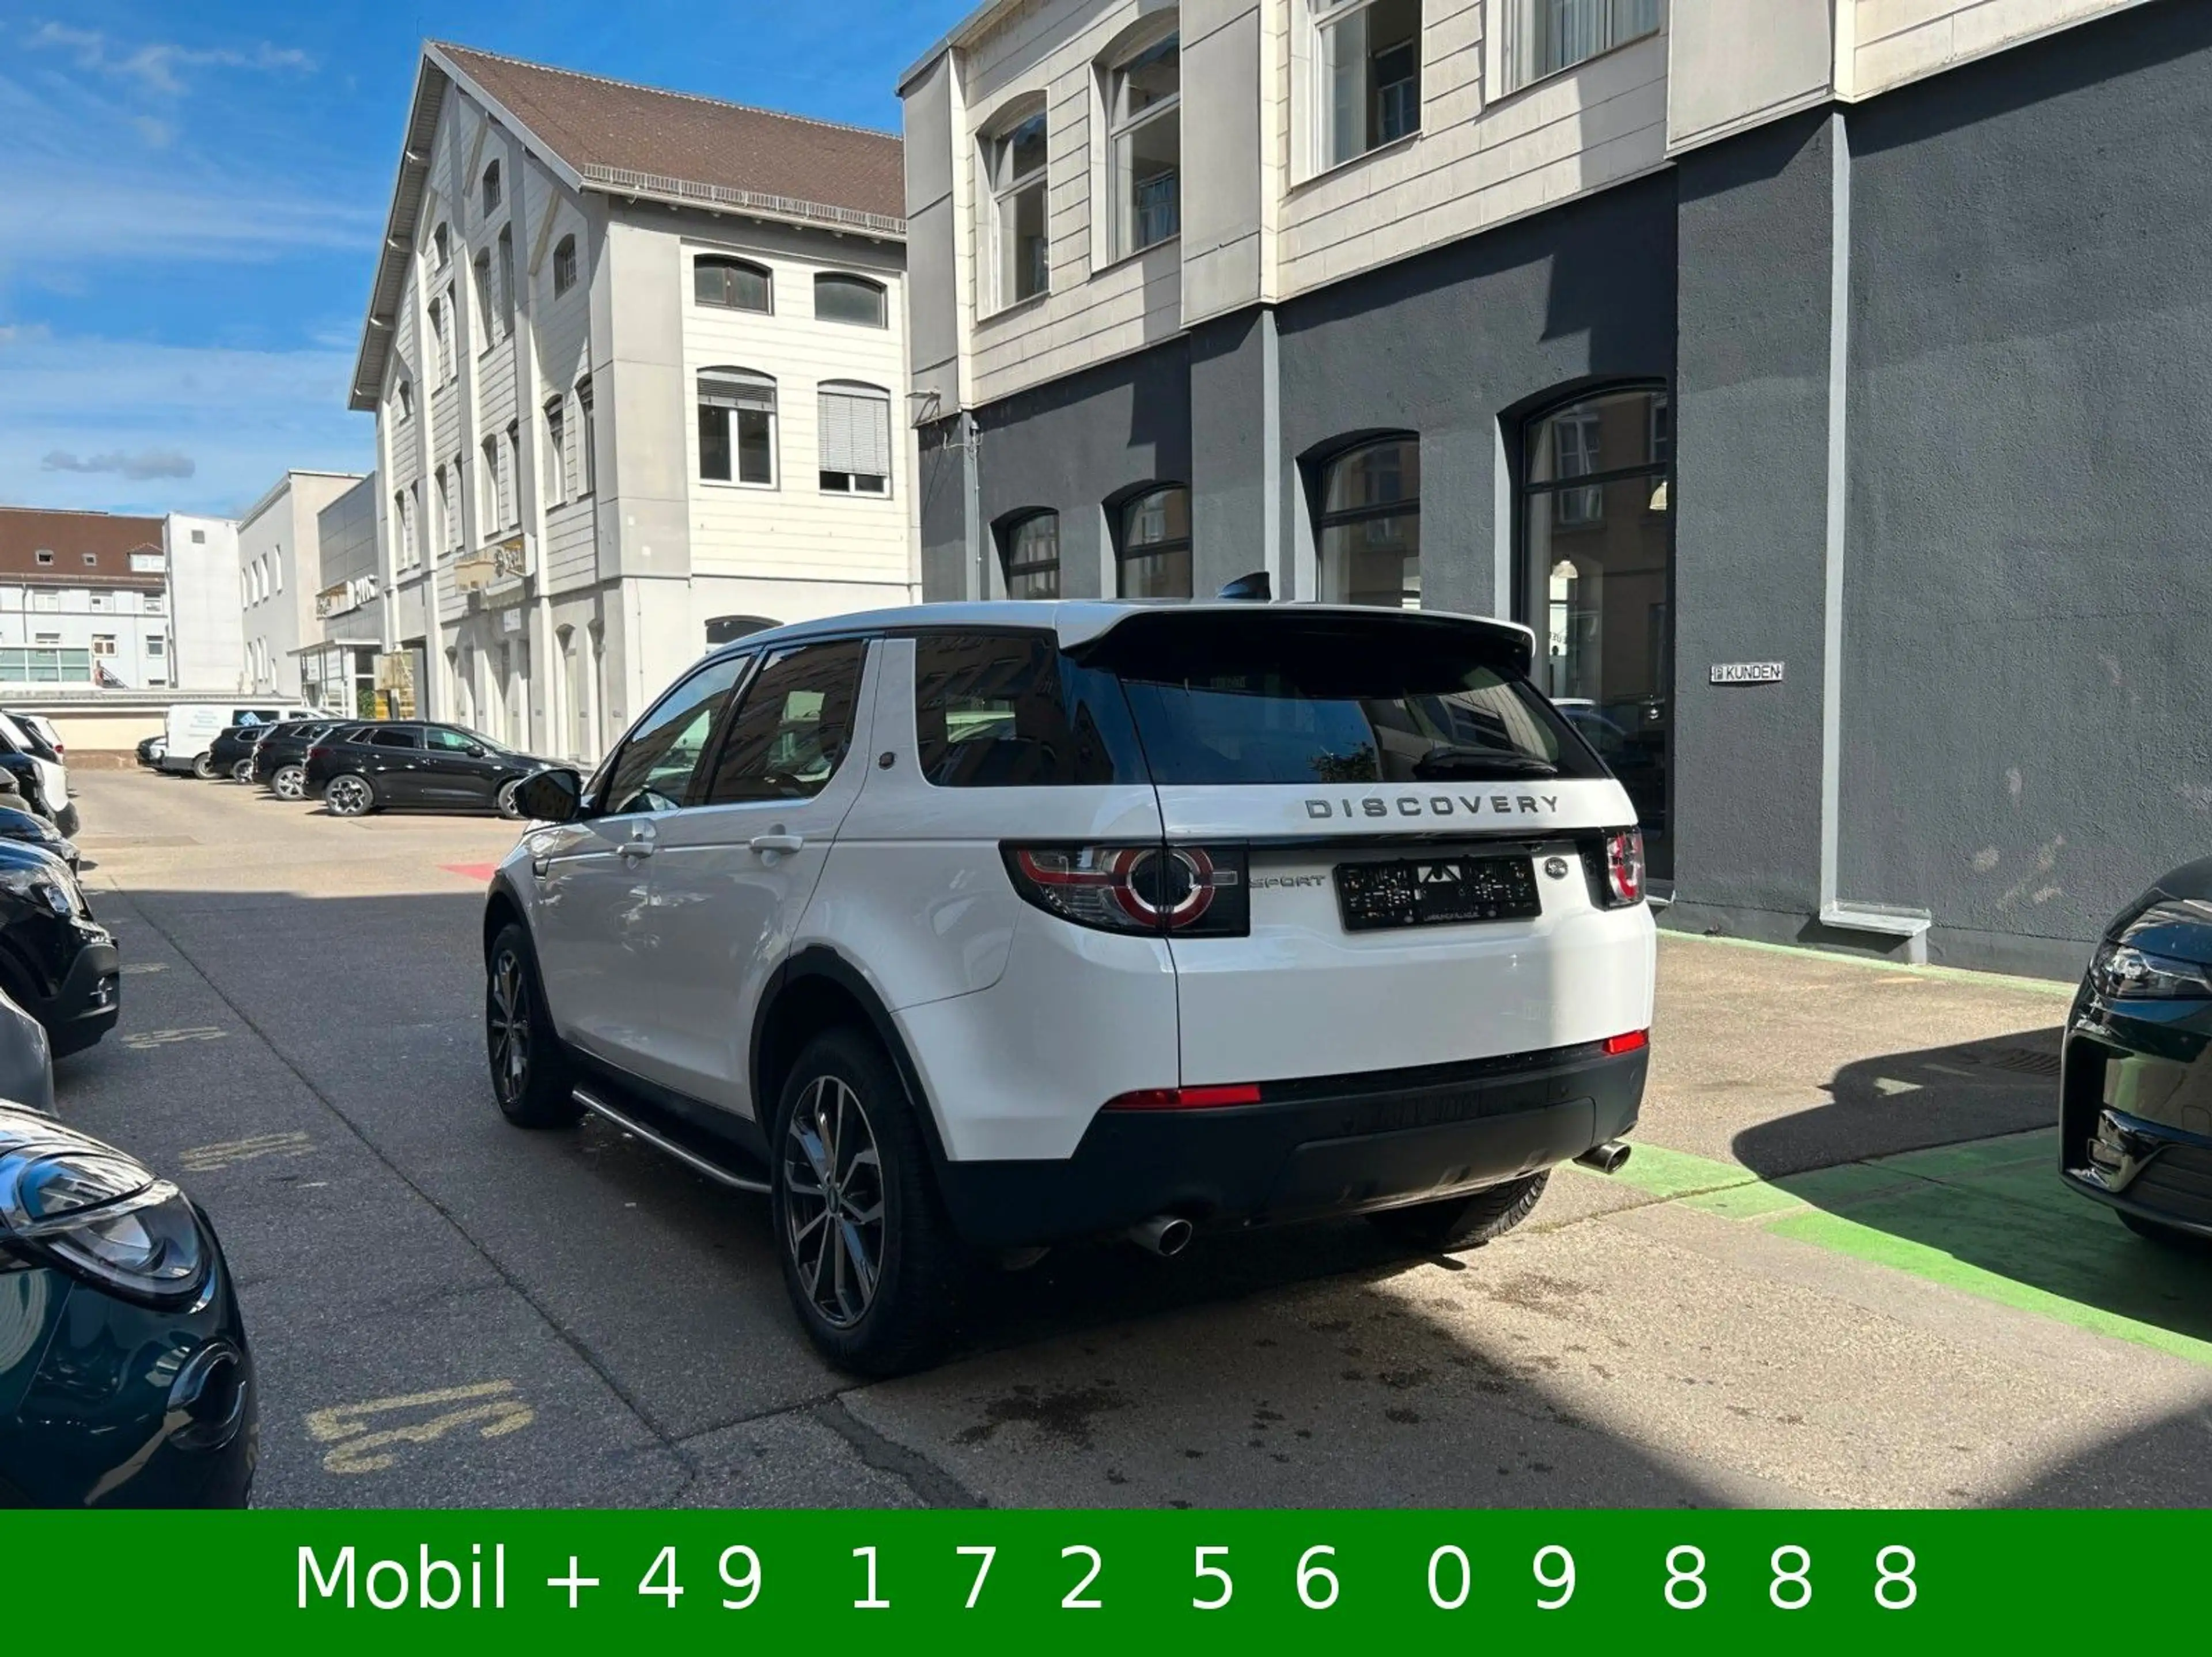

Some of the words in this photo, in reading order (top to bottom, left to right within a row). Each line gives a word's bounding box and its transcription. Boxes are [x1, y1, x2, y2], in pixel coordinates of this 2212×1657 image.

[1727, 665, 1781, 680] KUNDEN
[1305, 795, 1557, 819] DISCOVERY
[1249, 875, 1326, 888] SPORT
